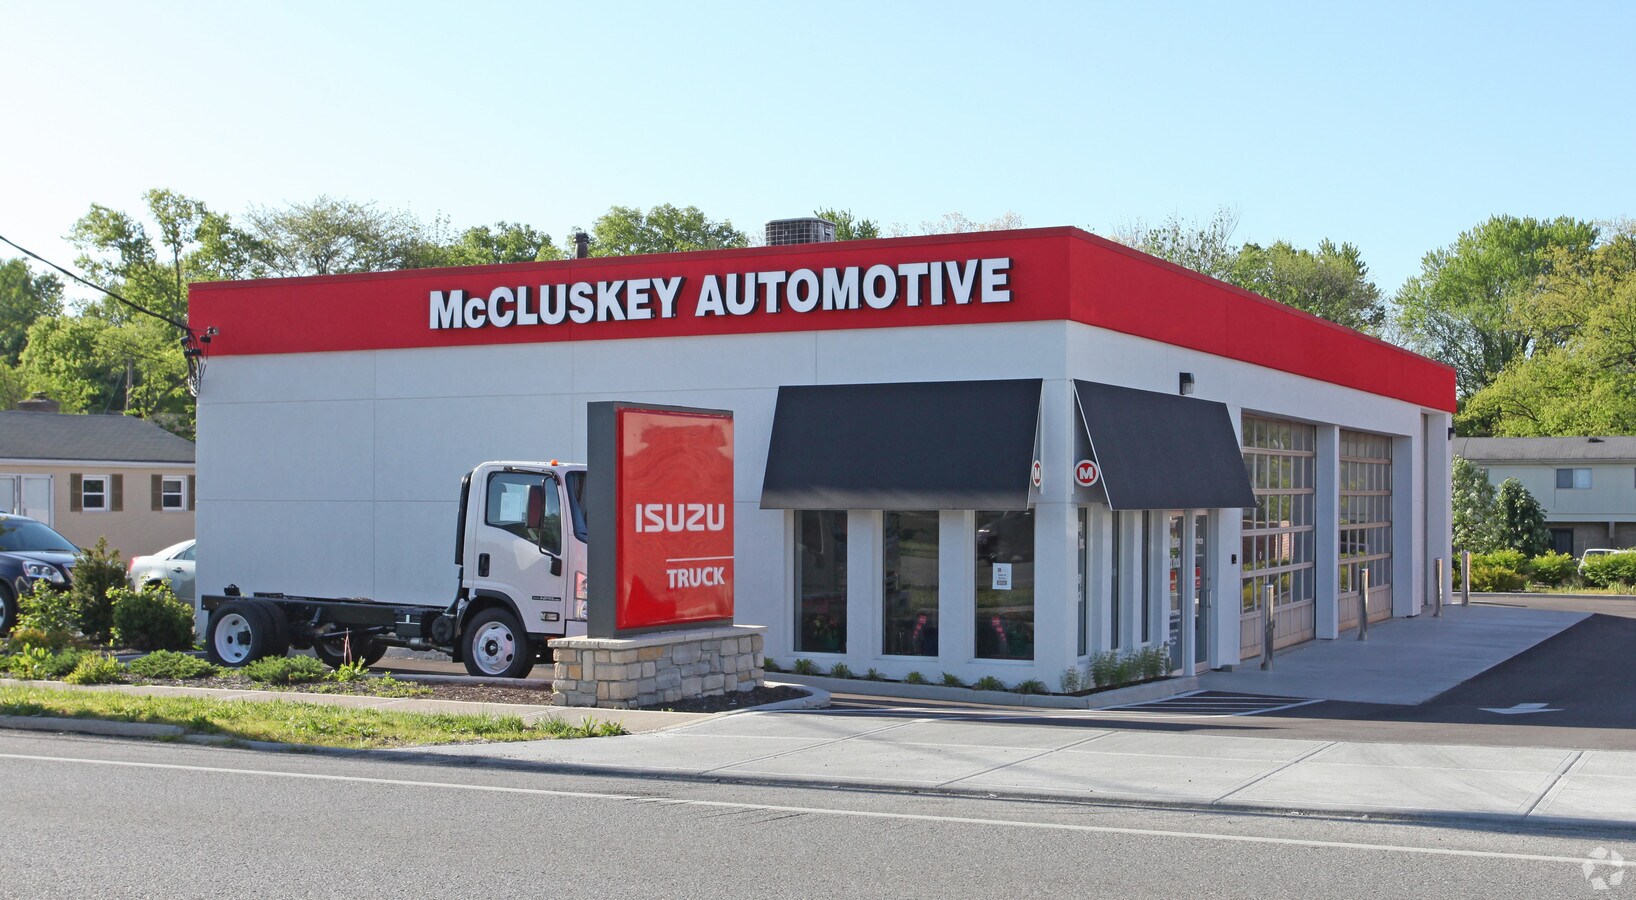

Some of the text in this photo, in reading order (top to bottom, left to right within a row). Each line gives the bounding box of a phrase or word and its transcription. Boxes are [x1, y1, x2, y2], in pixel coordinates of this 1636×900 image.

[429, 257, 1012, 329] McCLUSKEY AUTOMOTIVE
[1079, 466, 1093, 480] M
[635, 503, 725, 533] ISUZU
[666, 566, 725, 589] TRUCK
